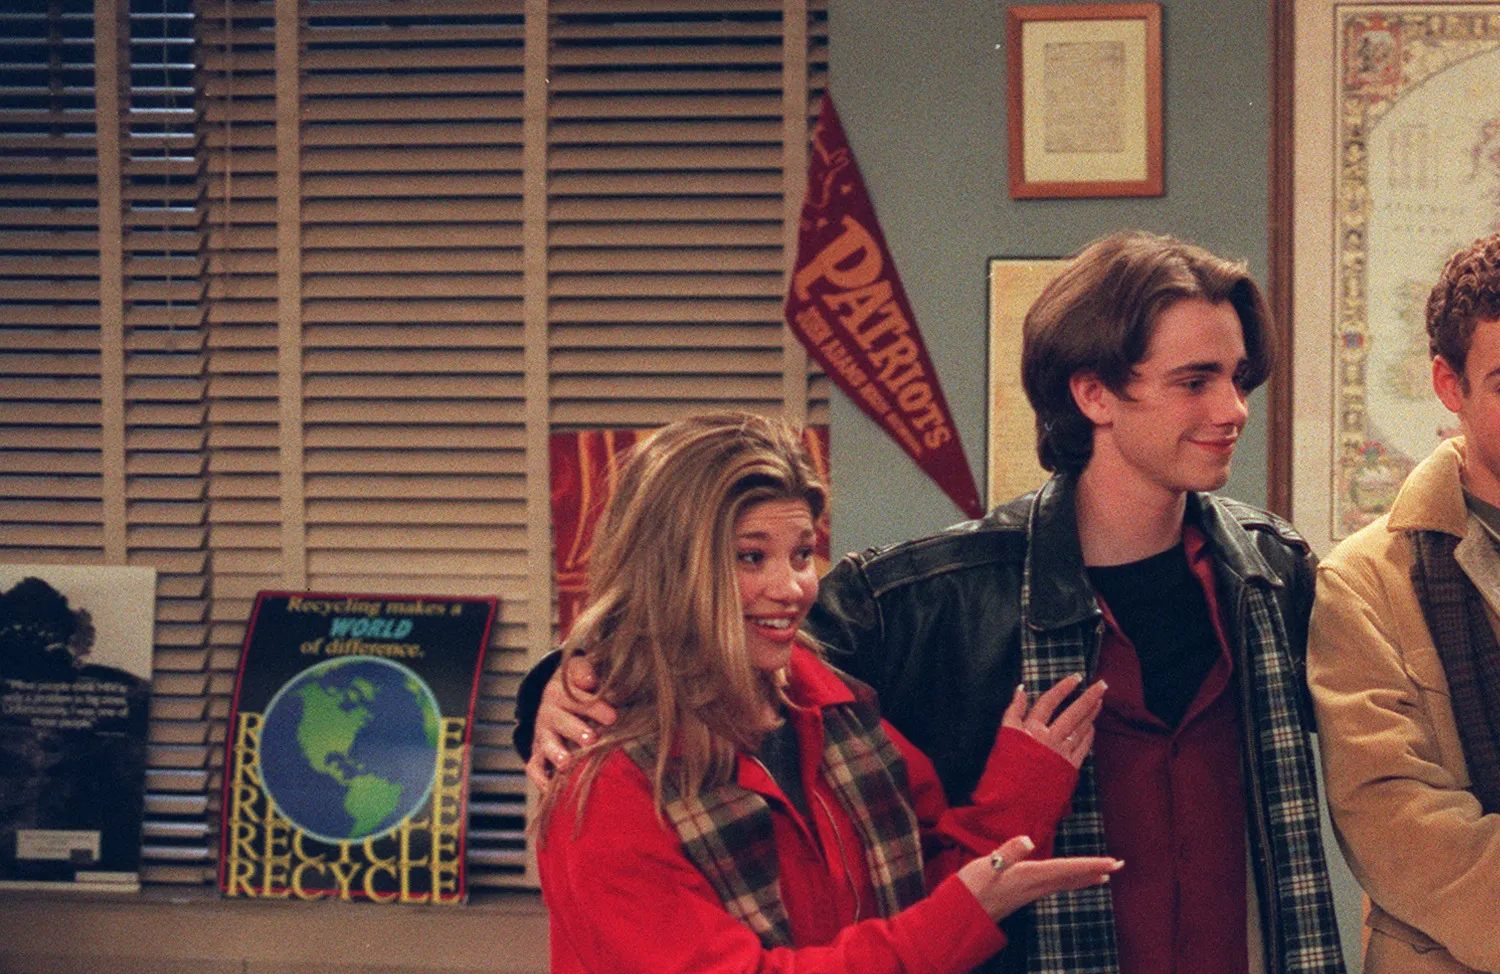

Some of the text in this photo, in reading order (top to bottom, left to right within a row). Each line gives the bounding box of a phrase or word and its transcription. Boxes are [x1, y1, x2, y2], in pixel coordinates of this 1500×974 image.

[795, 215, 951, 450] PATRIOTS
[286, 596, 464, 617] Recycling makes a
[329, 617, 416, 639] WORLD
[299, 637, 325, 655] of
[226, 858, 461, 904] RECYCLE
